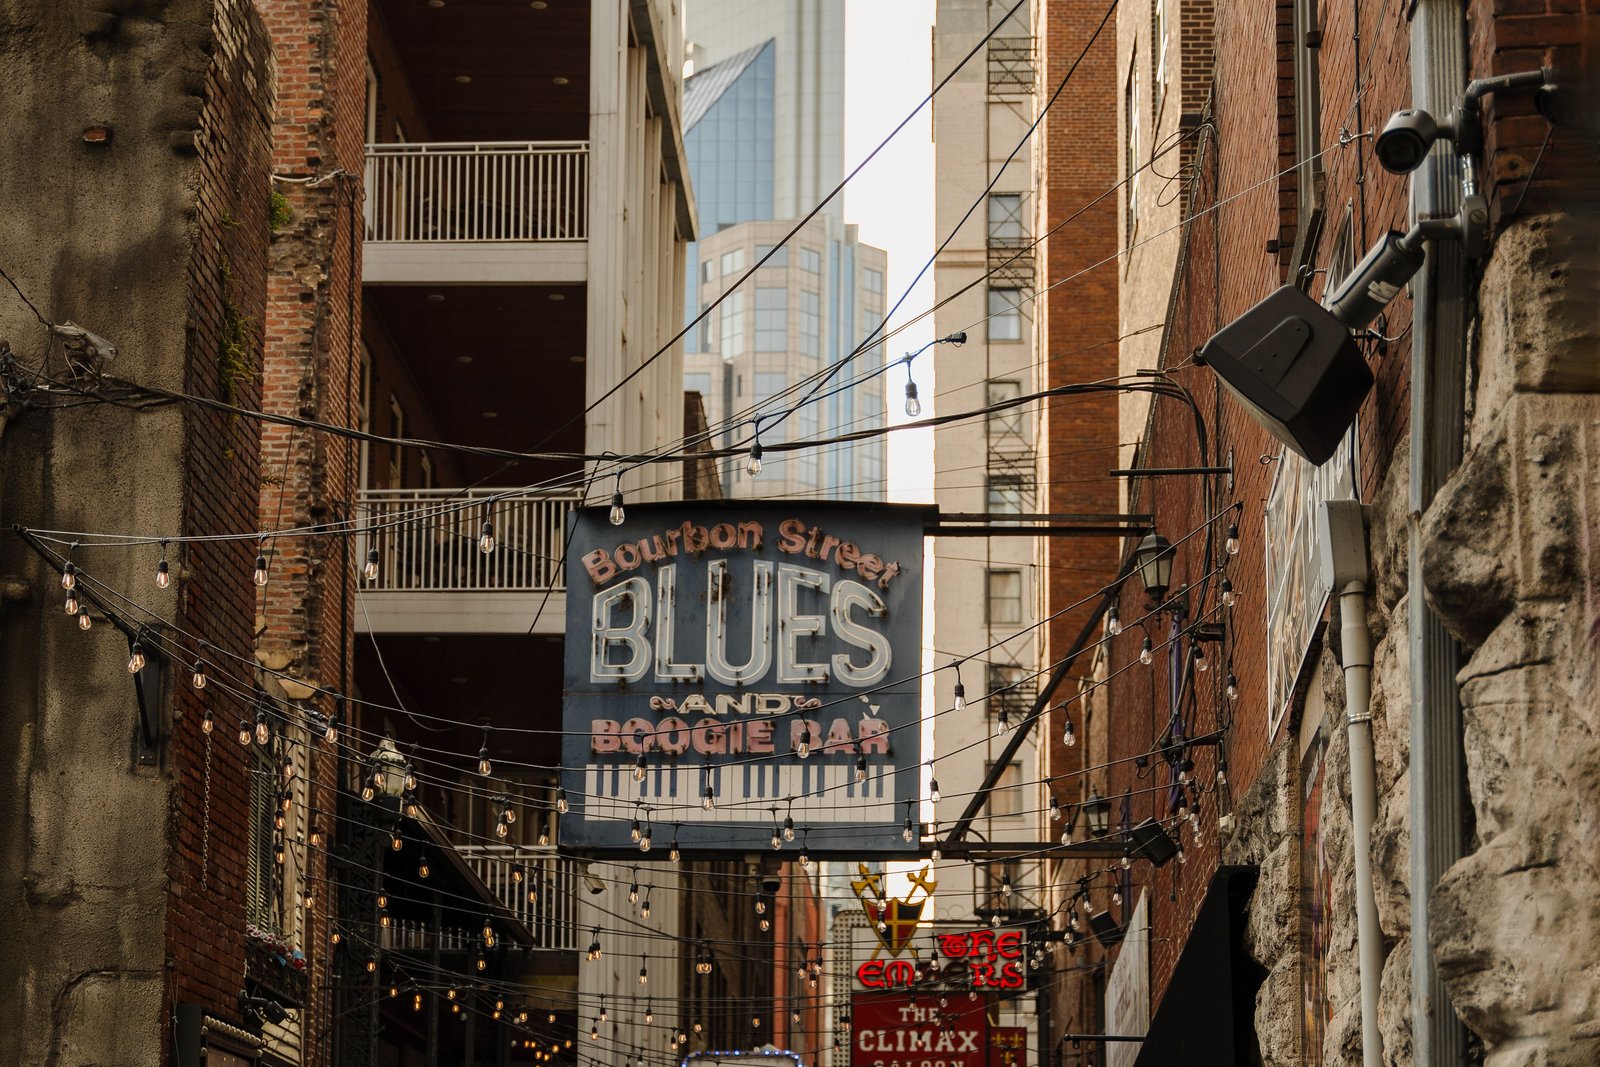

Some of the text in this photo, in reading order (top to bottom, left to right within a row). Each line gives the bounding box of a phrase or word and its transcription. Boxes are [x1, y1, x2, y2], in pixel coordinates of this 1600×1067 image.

[582, 519, 900, 590] Bourbon Street
[590, 558, 893, 687] BLUES
[676, 694, 792, 715] AND
[591, 717, 890, 754] BOOGIE BAR
[938, 930, 1023, 962] THE
[898, 1007, 939, 1022] THE
[859, 1030, 979, 1052] CLIMAX
